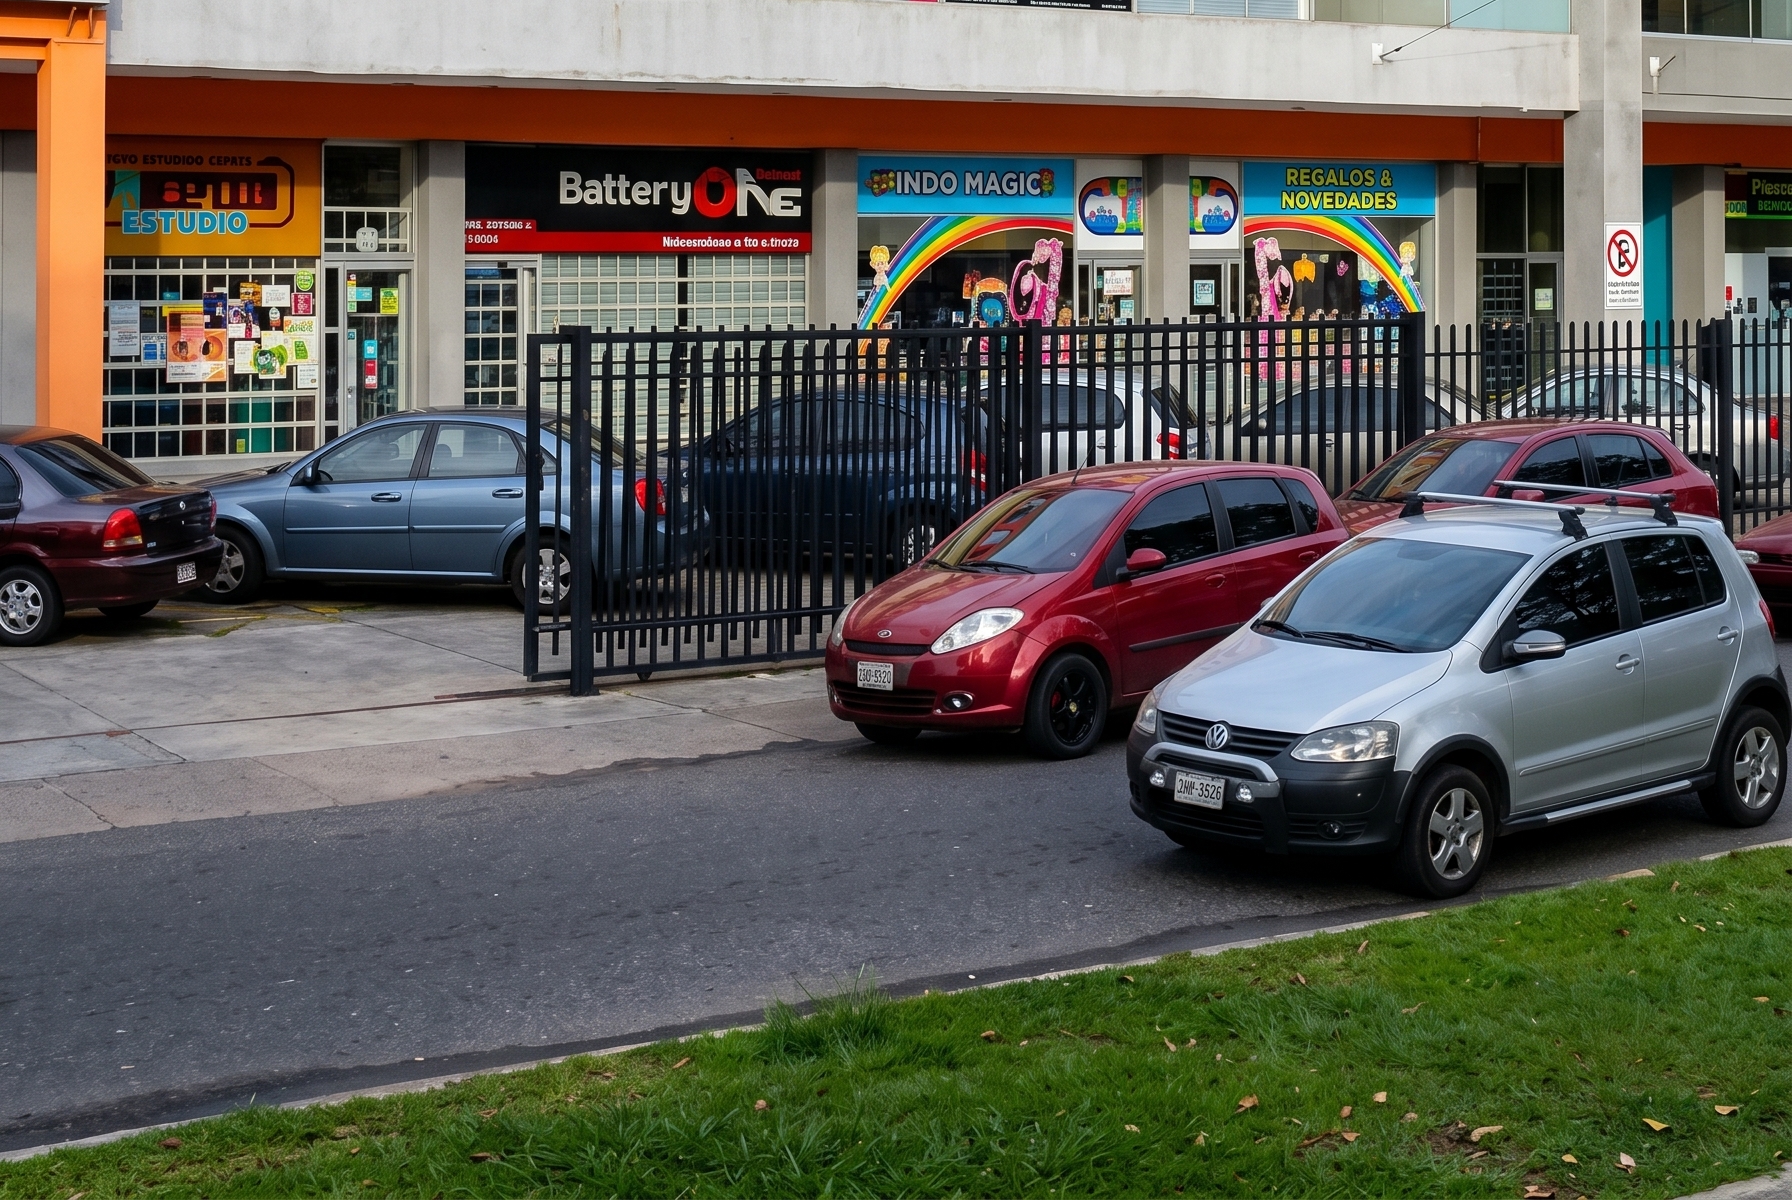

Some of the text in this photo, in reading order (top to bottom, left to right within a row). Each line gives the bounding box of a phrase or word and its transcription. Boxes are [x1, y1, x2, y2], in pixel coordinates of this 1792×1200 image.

[895, 170, 1041, 196] INDO MAGIC
[1285, 166, 1392, 188] REGALOS &
[1281, 191, 1398, 211] NOVEDADES
[122, 209, 248, 234] ESTUDIO
